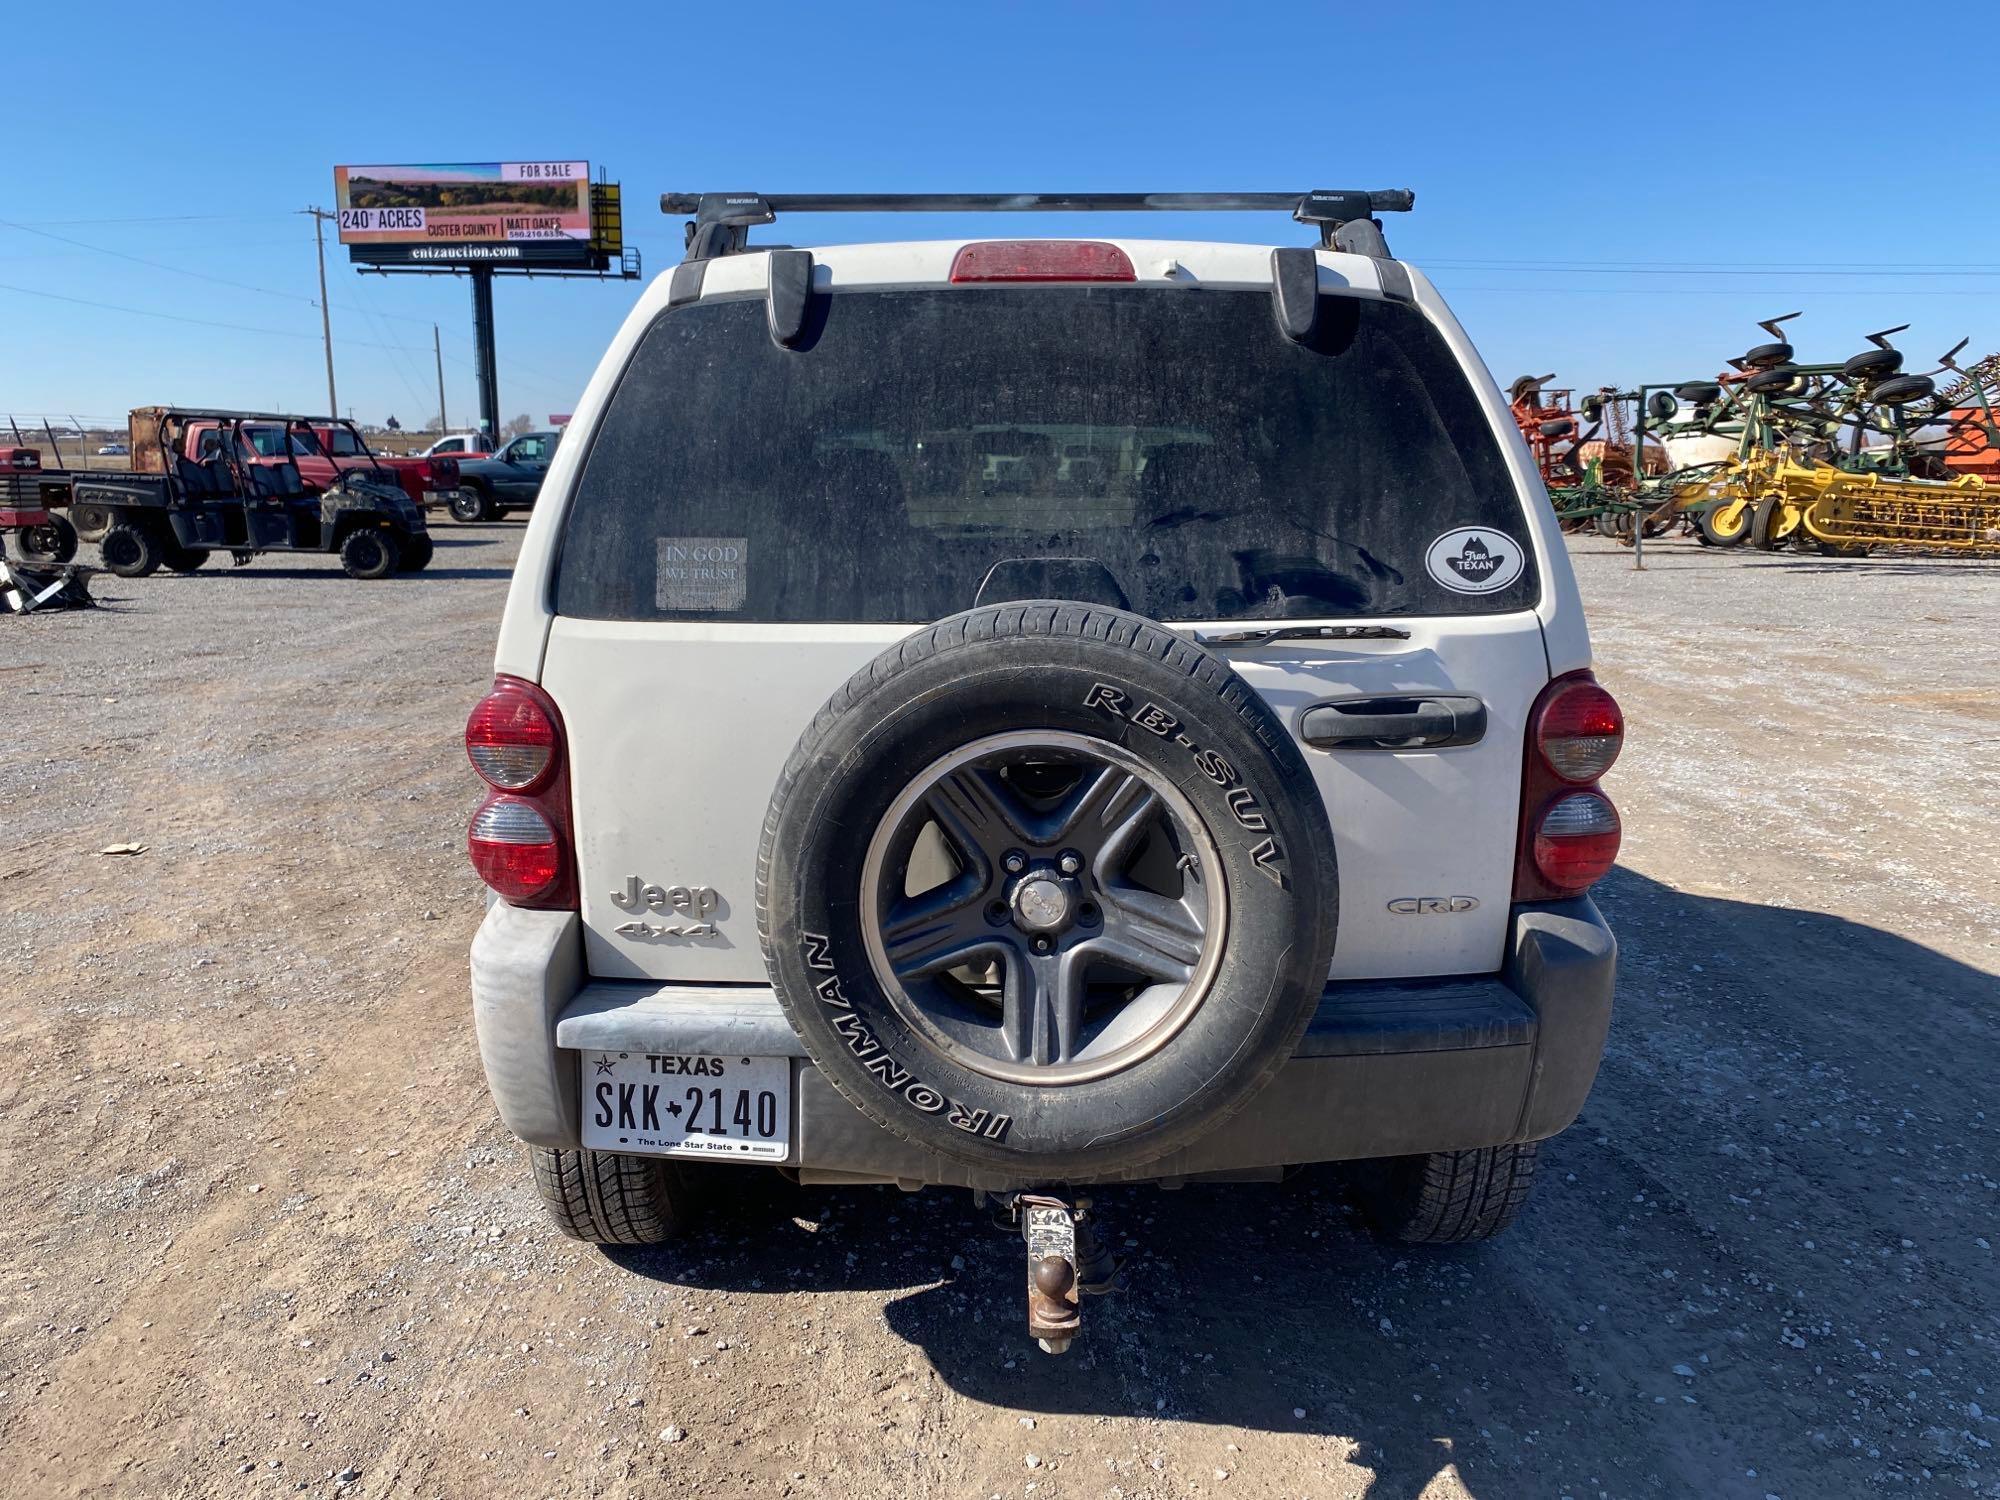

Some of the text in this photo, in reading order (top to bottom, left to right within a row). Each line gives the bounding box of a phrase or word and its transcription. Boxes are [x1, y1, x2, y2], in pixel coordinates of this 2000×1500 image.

[520, 164, 571, 178] FOR SALE
[379, 209, 422, 229] ACRES
[506, 217, 561, 229] MATT OAKES
[428, 223, 497, 237] CUSTER COUNTY
[412, 244, 520, 259] entzauction.com
[666, 546, 738, 562] IN GOD
[666, 567, 737, 579] WE TRUST
[1457, 560, 1494, 570] TEXAN
[1083, 682, 1283, 889] RB-SUV
[609, 875, 718, 919] Jeep
[1386, 895, 1481, 915] CRD
[613, 921, 719, 940] 4x4
[803, 931, 1013, 1139] IRONMAN
[645, 1055, 725, 1077] TEXAS
[595, 1082, 777, 1138] SKK 2140
[637, 1138, 733, 1151] The Lone Star State
